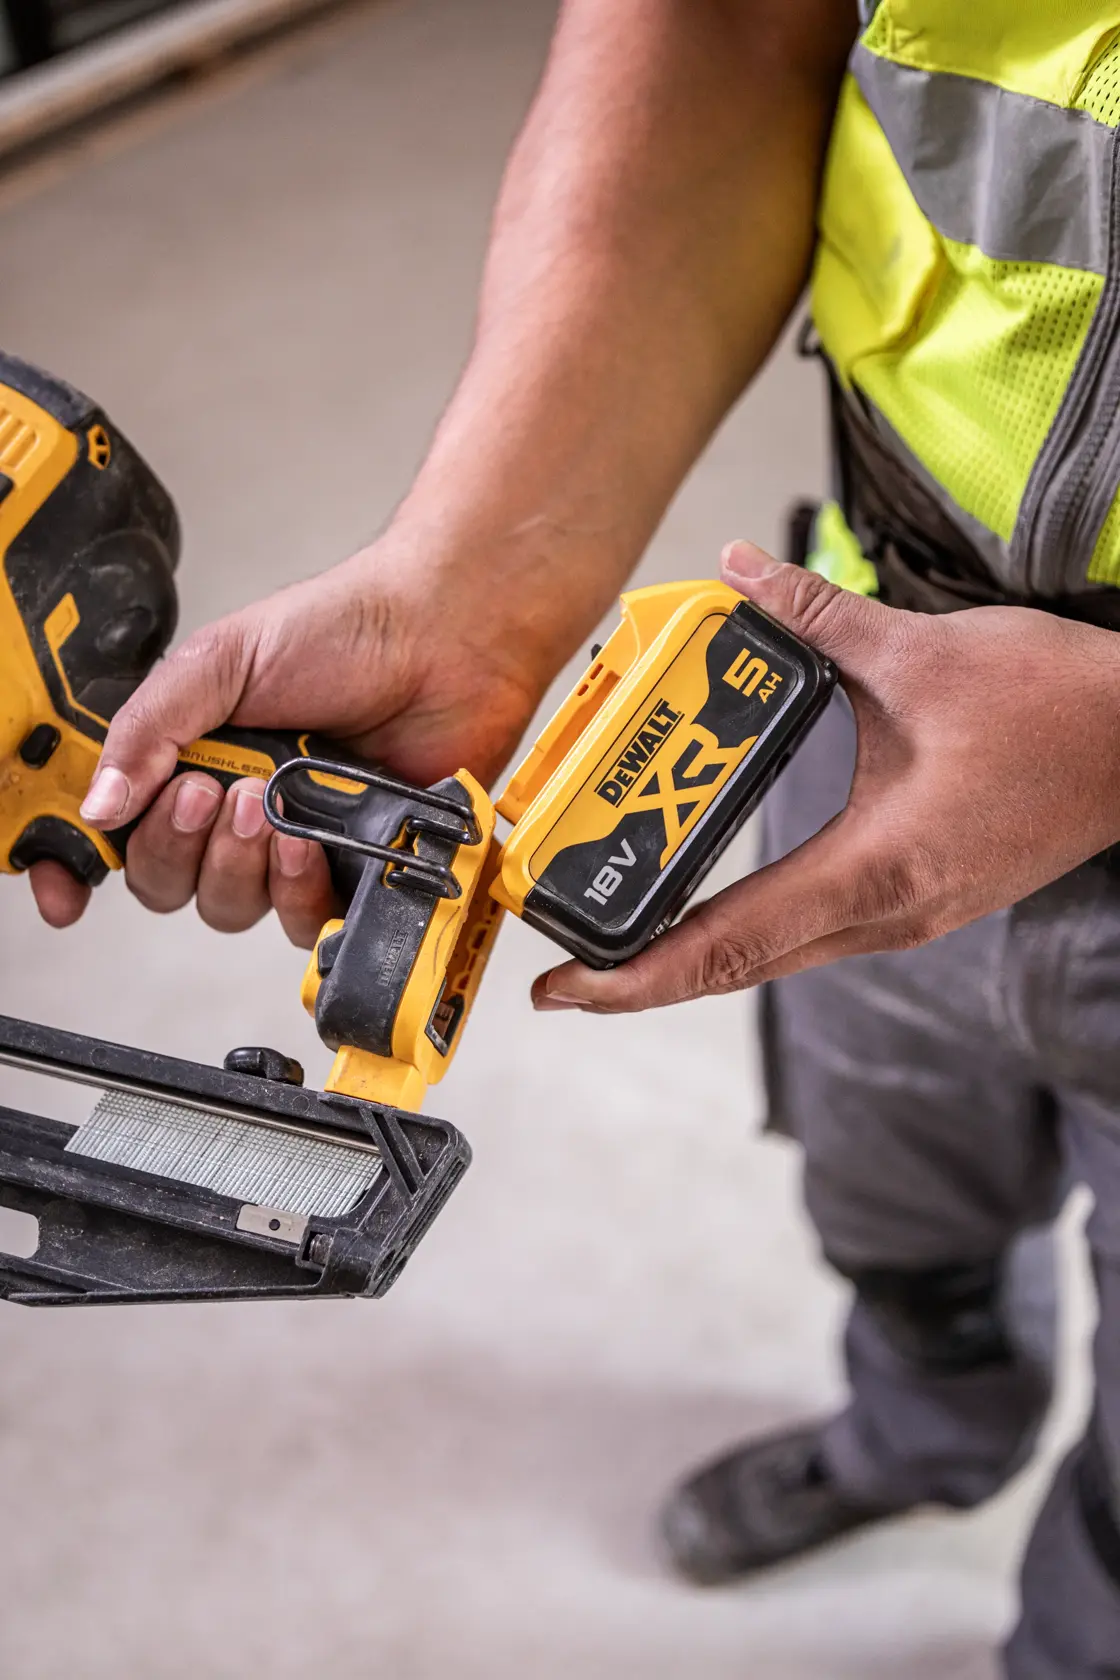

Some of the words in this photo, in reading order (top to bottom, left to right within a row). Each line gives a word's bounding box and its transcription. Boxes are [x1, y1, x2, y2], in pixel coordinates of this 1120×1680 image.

[722, 648, 769, 697] 5
[757, 671, 783, 704] AH
[597, 699, 678, 807] DEWALT
[626, 723, 759, 871] XR
[584, 838, 637, 905] 18V
